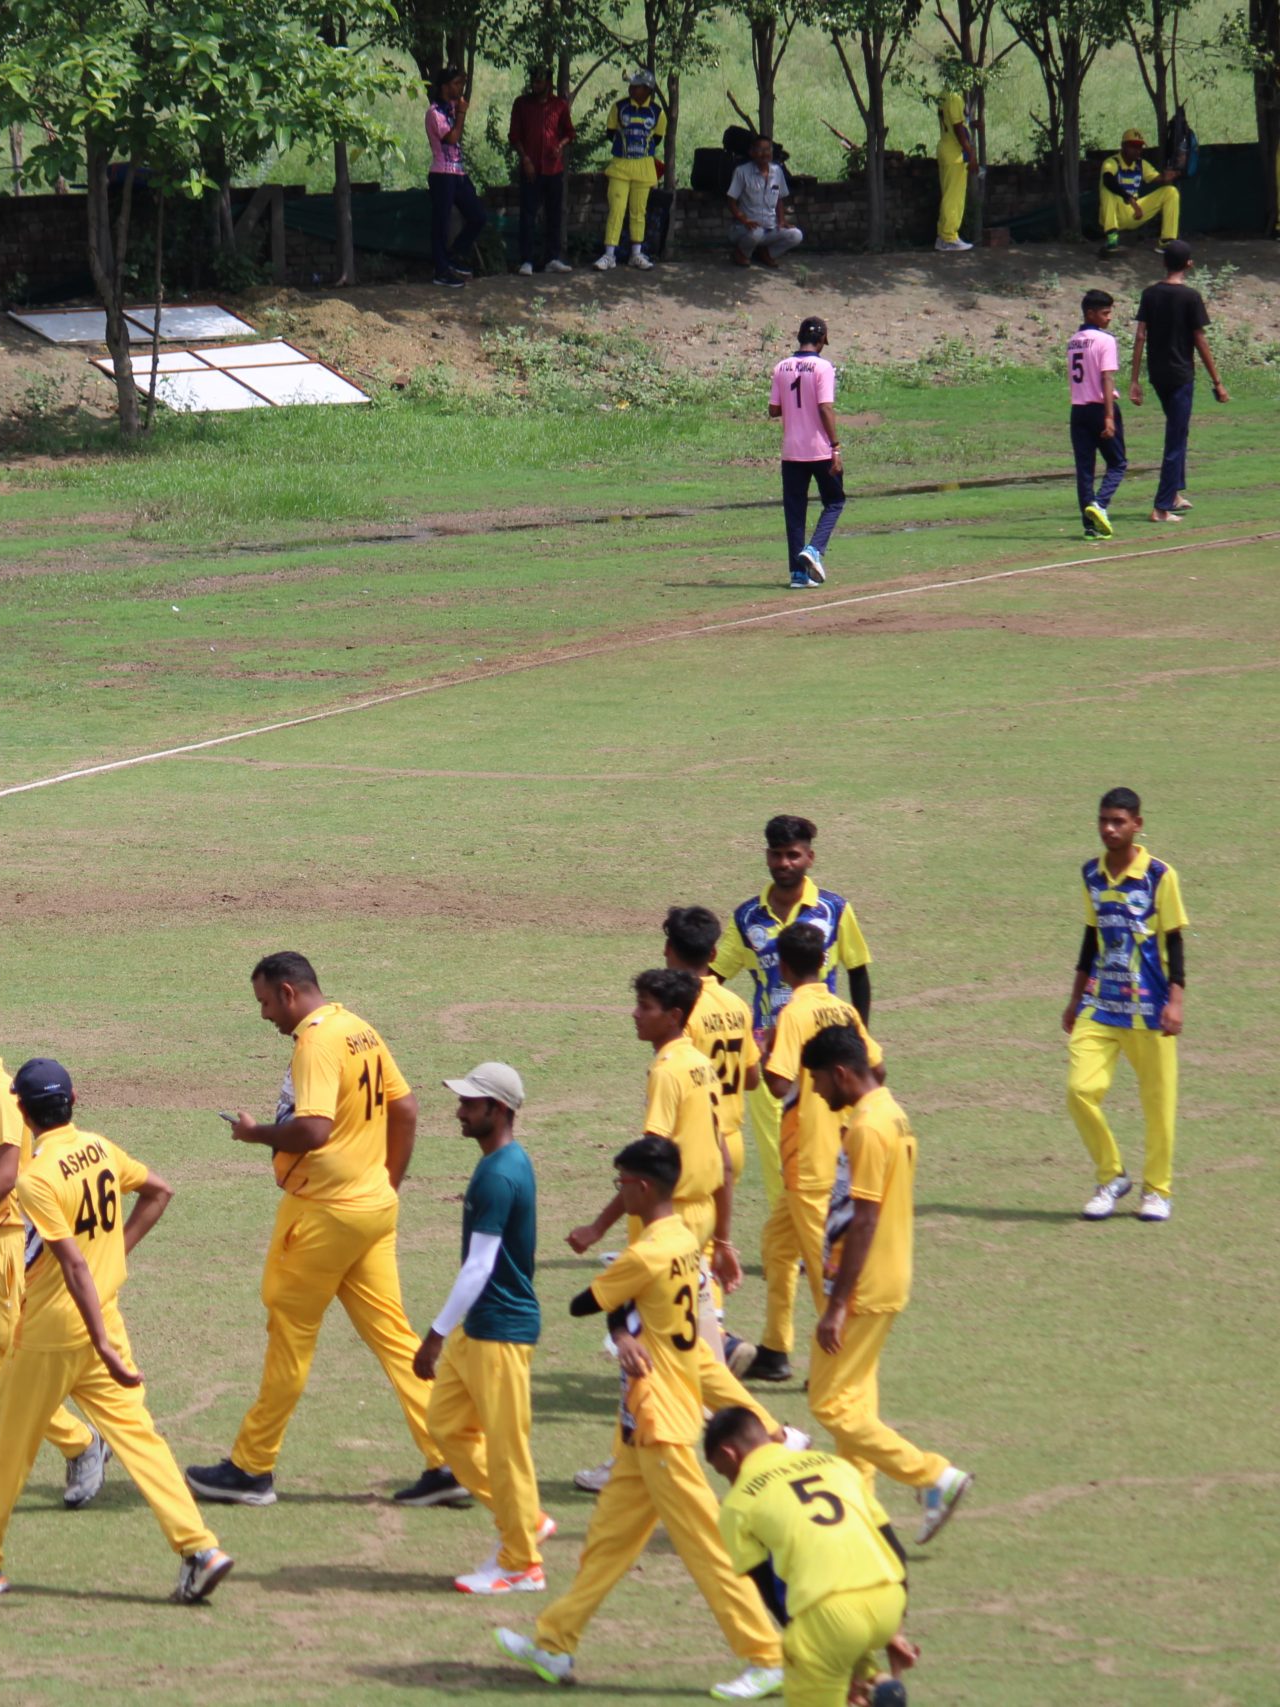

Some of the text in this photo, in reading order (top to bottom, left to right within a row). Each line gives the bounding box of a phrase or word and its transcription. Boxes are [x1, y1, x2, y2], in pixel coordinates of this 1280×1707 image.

[791, 375, 802, 409] 1
[1072, 352, 1084, 384] 5
[358, 1054, 384, 1121] 14
[710, 1038, 744, 1096] 27
[58, 1141, 108, 1181] ASHOK
[74, 1168, 117, 1241] 46
[671, 1284, 697, 1351] 3
[788, 1473, 845, 1527] 5
